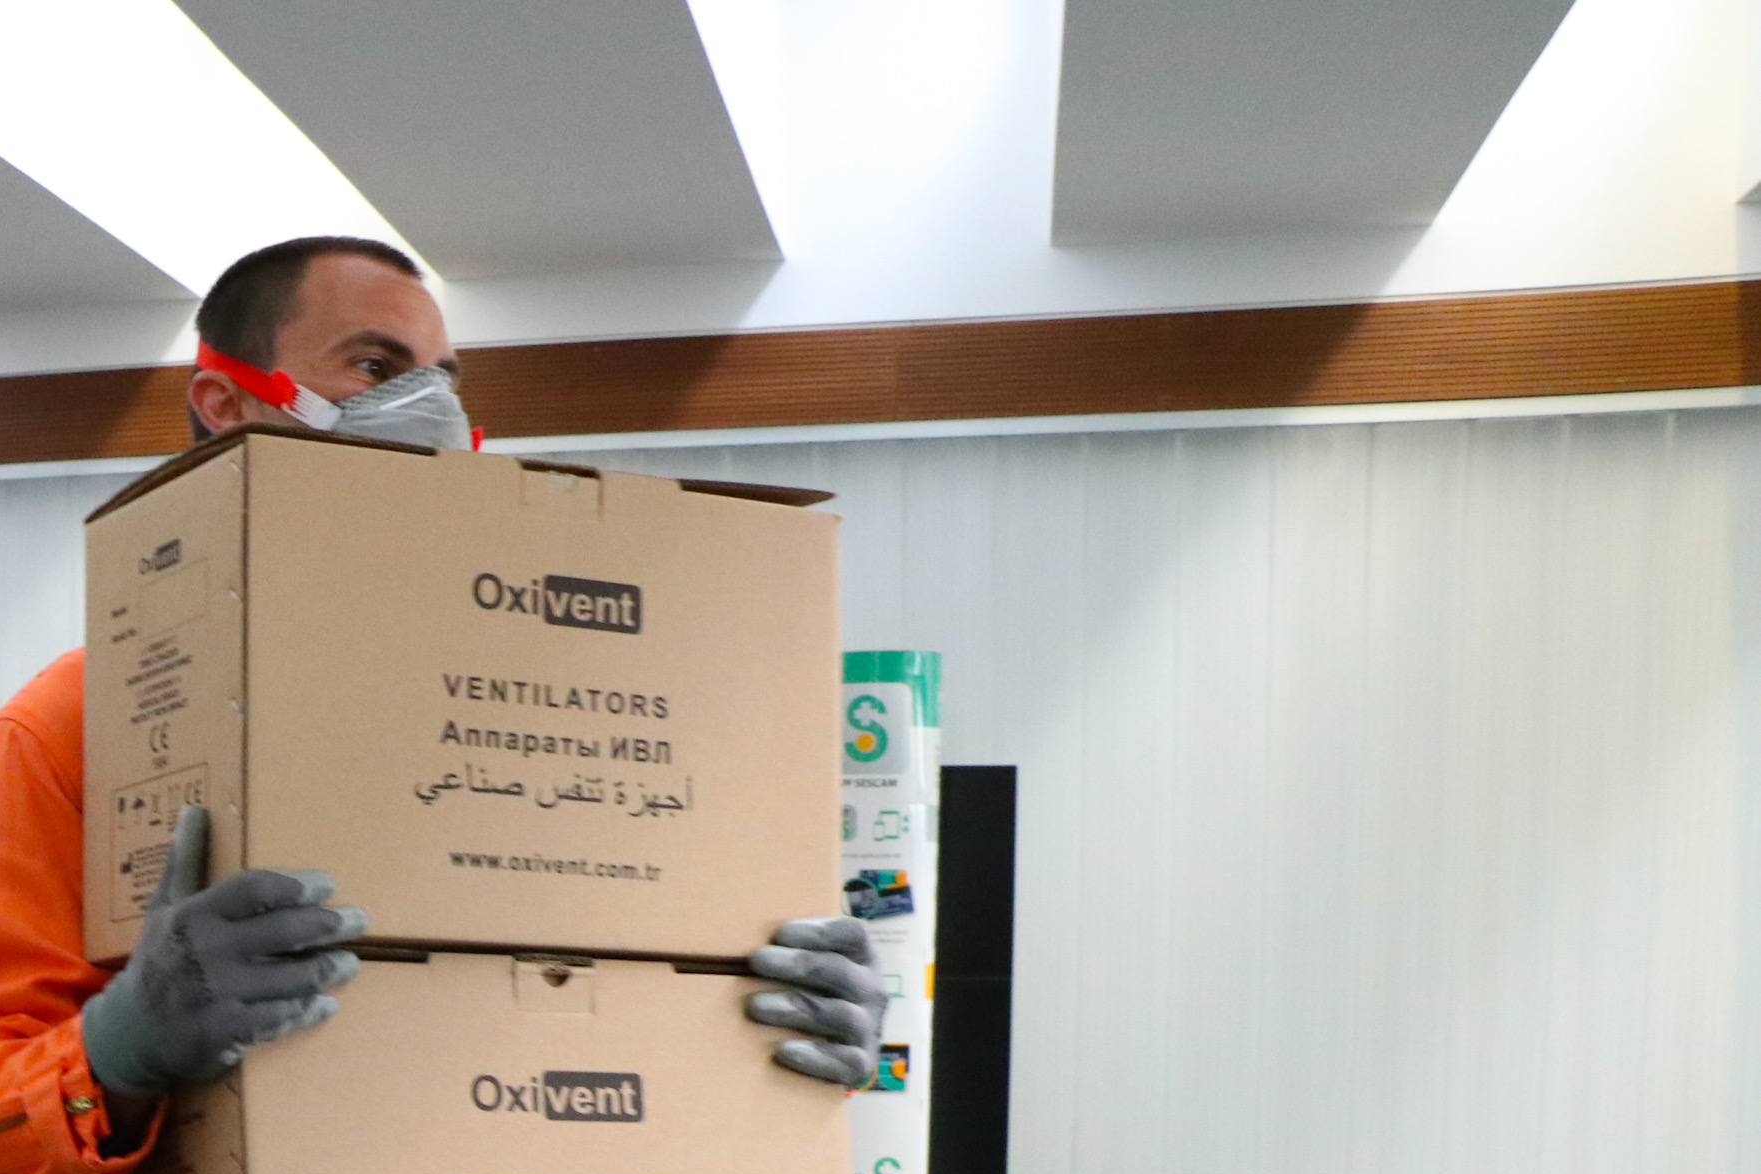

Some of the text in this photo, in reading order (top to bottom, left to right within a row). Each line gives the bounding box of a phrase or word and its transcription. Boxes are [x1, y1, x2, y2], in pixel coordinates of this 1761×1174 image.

[472, 573, 642, 635] Oxivent
[443, 674, 669, 720] VENTILATORS
[440, 720, 672, 765] Аппараты ИВЛ
[414, 762, 525, 806] صناعي
[613, 776, 692, 818] أجهزة
[449, 852, 662, 881] www.oxivent.com.tr
[471, 1070, 644, 1123] Oxivent
